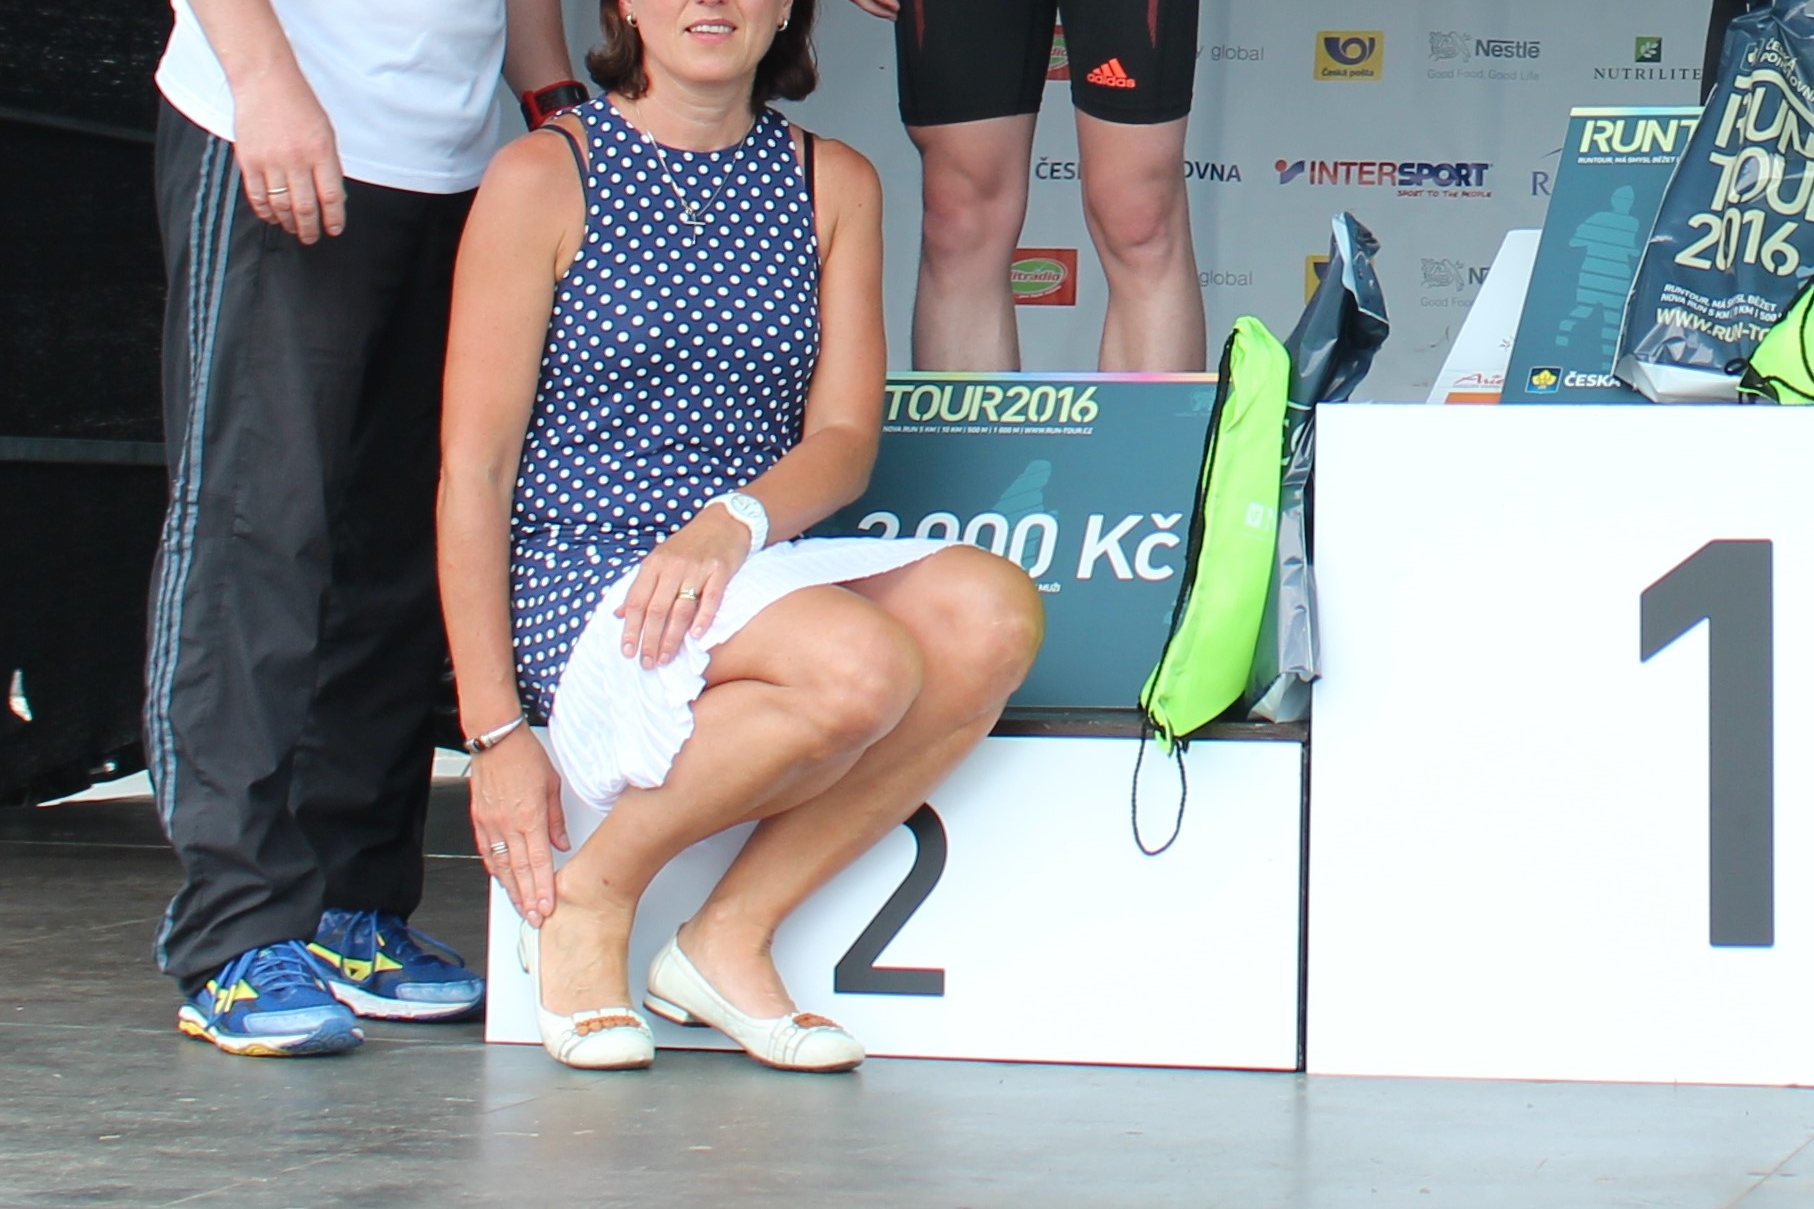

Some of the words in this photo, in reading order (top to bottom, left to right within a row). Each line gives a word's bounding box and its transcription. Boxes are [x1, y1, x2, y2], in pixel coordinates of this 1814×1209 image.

[1211, 44, 1265, 62] global
[1086, 72, 1136, 89] adidas
[1321, 67, 1348, 77] Česká
[1349, 67, 1375, 78] pošta
[1427, 69, 1455, 80] Good
[1488, 69, 1517, 81] Good
[1593, 67, 1701, 80] NUTRILITE
[1309, 160, 1489, 187] INTERSPORT
[1674, 206, 1800, 277] 2016
[1198, 270, 1253, 288] global
[1660, 293, 1686, 305] NOVA
[1687, 300, 1708, 314] RUN
[1075, 512, 1184, 581] Kč
[1640, 538, 1774, 947] 1
[834, 802, 948, 996] 2
